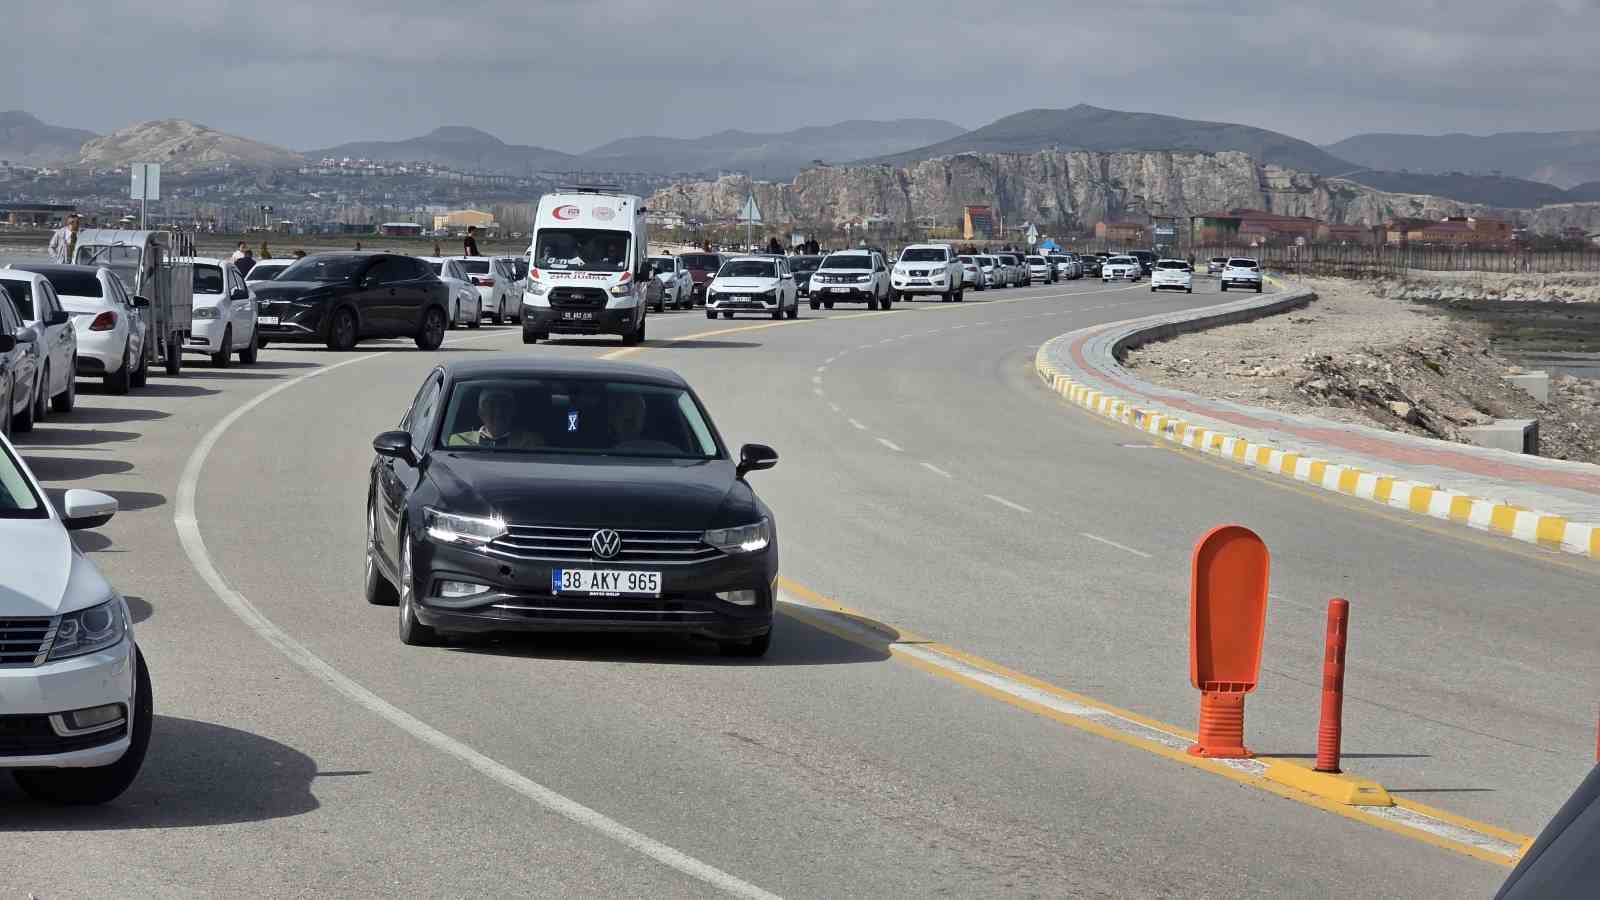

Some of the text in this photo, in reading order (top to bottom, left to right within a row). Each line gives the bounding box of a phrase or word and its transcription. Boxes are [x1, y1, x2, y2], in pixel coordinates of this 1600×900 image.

[563, 571, 582, 589] 38
[590, 572, 620, 590] AKY
[628, 573, 657, 591] 965
